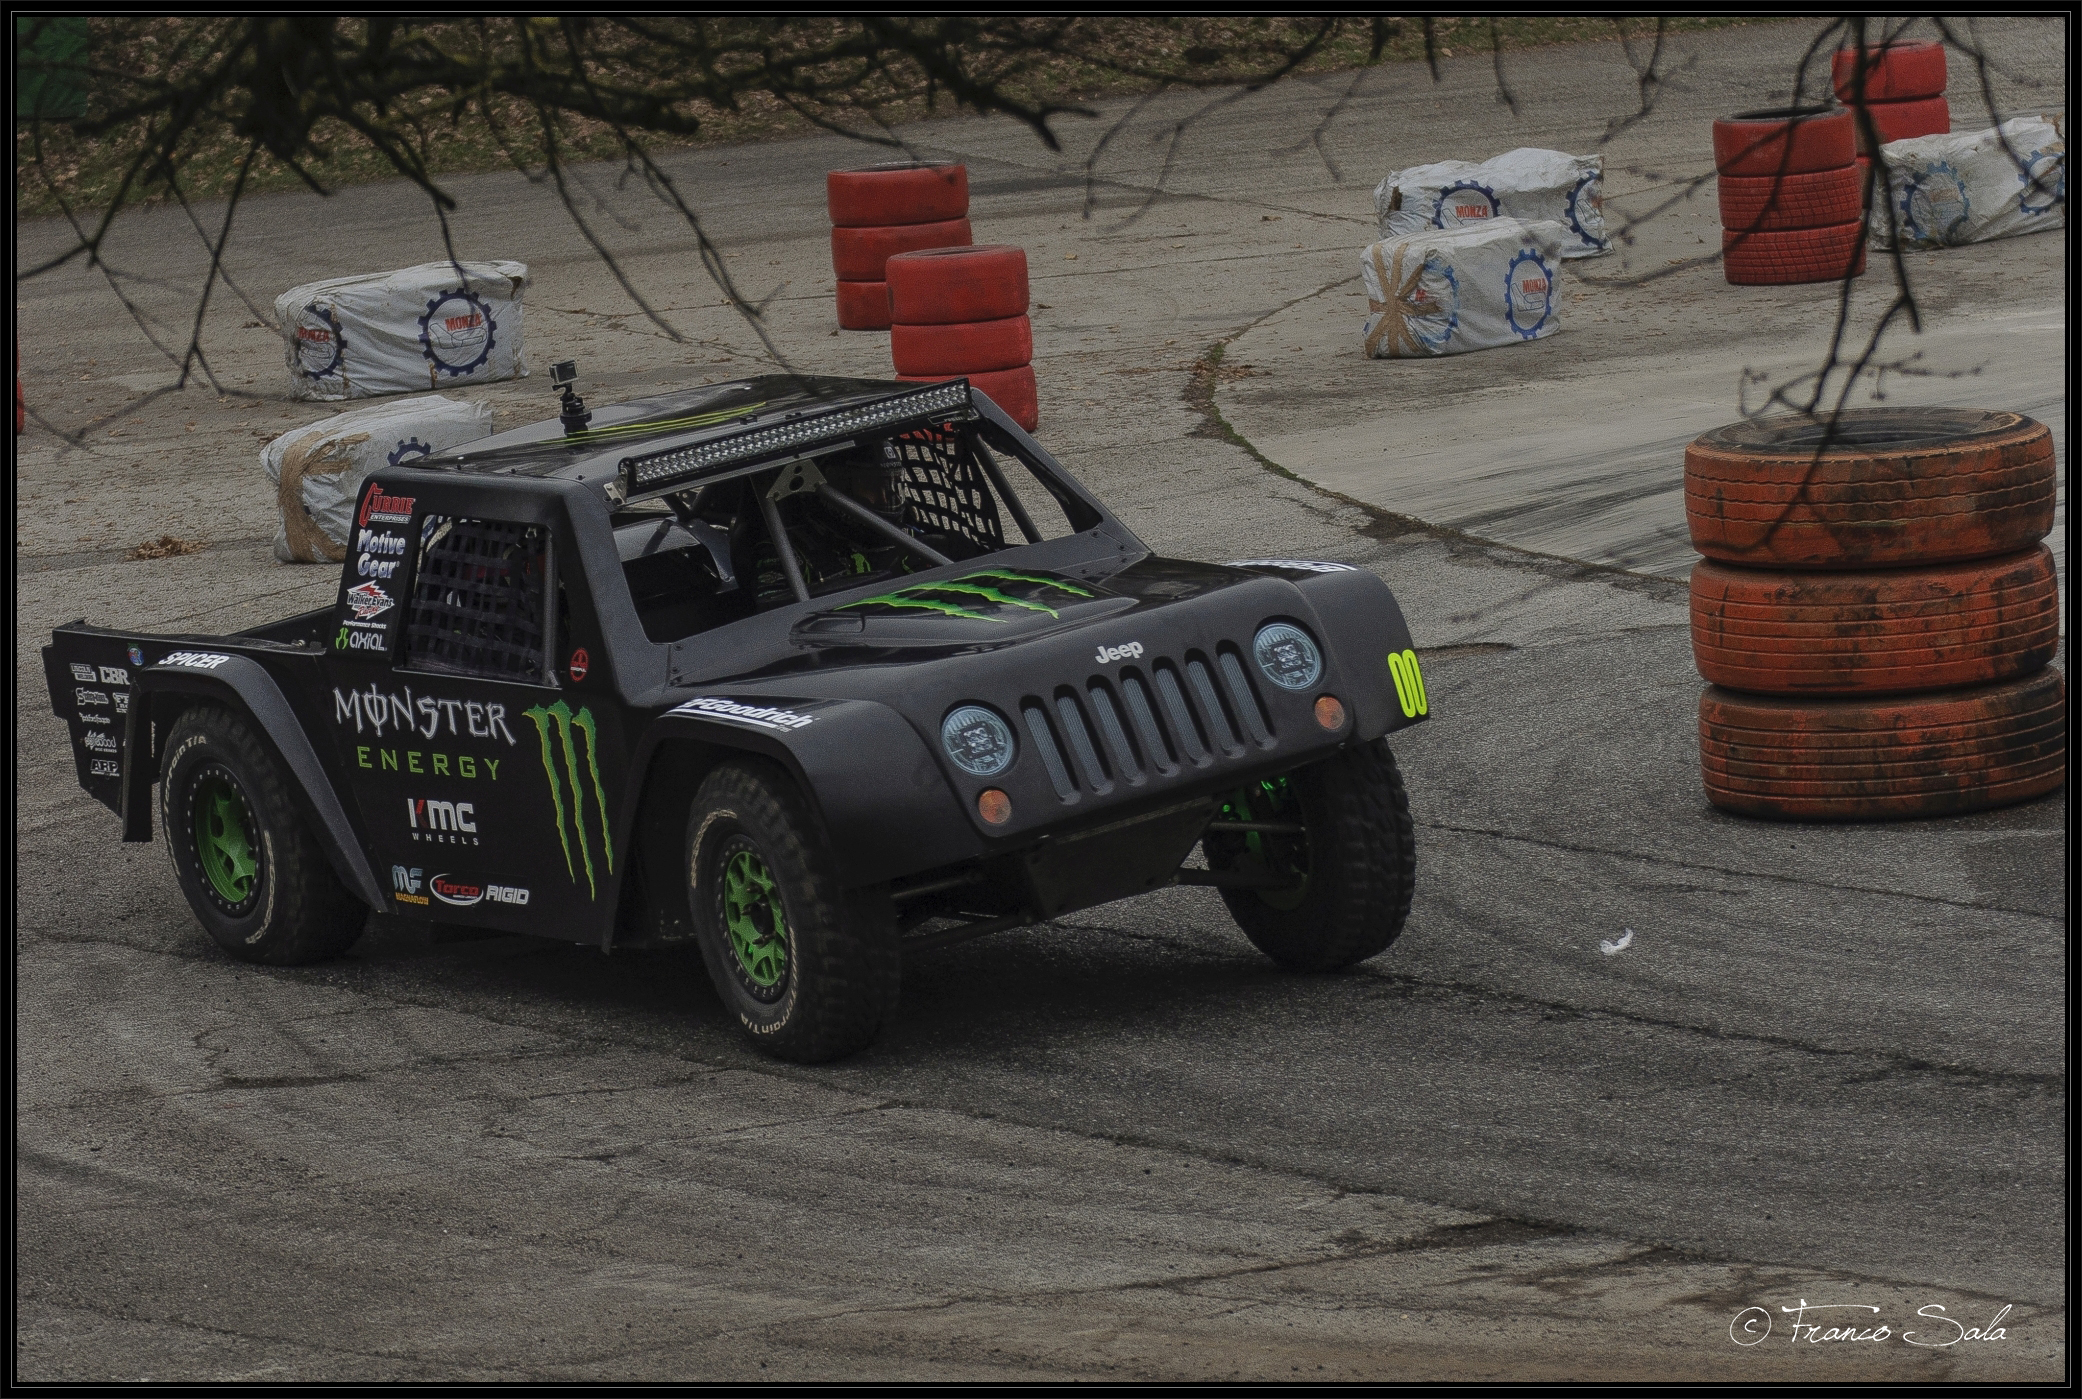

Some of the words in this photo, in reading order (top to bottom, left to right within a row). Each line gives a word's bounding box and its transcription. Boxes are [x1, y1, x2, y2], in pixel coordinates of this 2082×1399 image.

[1455, 205, 1488, 218] MONZA
[1523, 278, 1547, 293] MONZA
[445, 313, 482, 331] MONZA
[358, 482, 414, 528] CURRIE
[368, 513, 411, 524] ENTERPRISES
[356, 528, 406, 556] Motive
[357, 552, 395, 579] Gear
[372, 596, 393, 608] Evans
[158, 652, 230, 669] SPICER
[1095, 641, 1144, 664] Jeep
[98, 666, 131, 685] CBR
[1387, 649, 1428, 718] 00
[333, 682, 517, 747] MONSTER
[91, 759, 119, 772] ARP
[357, 745, 500, 782] ENERGY
[412, 832, 479, 846] WHEELS
[435, 880, 479, 896] Torco
[486, 885, 530, 905] RIGID
